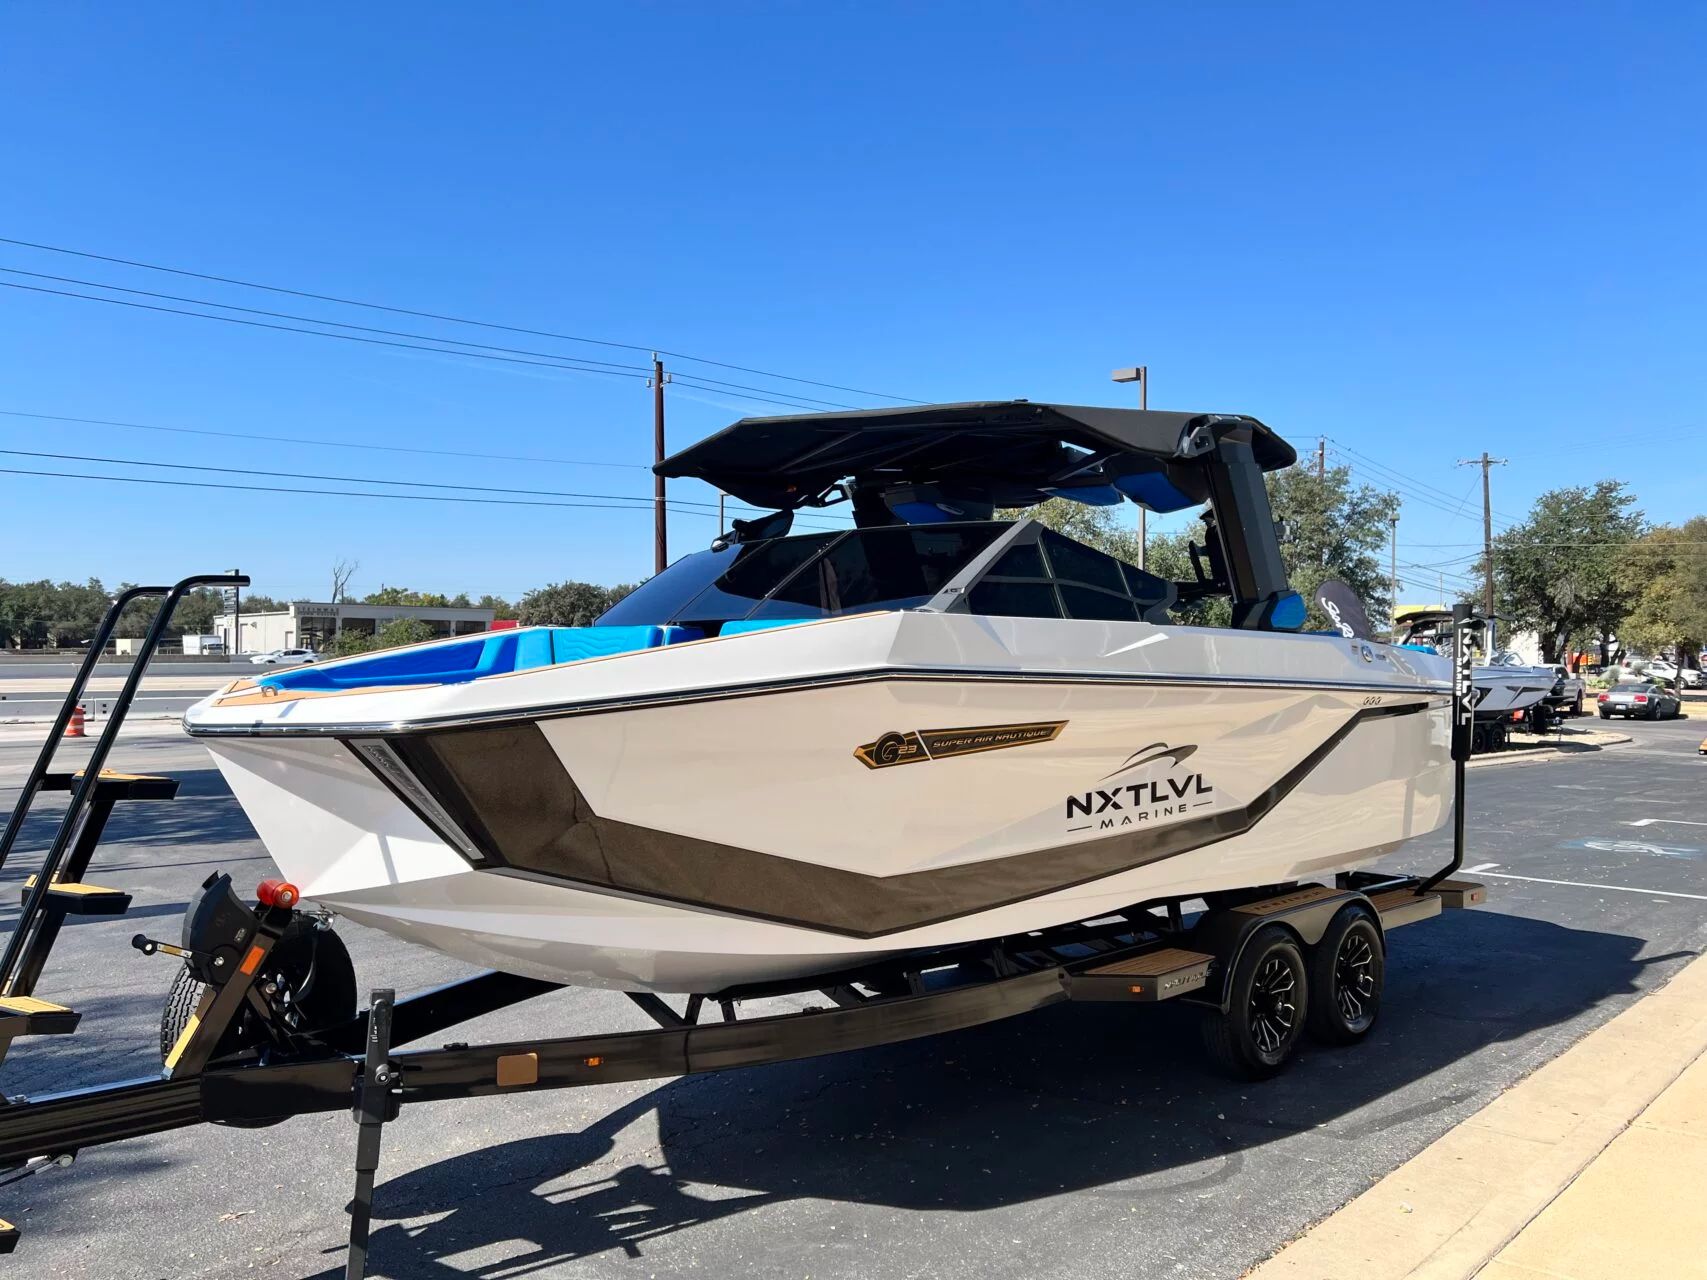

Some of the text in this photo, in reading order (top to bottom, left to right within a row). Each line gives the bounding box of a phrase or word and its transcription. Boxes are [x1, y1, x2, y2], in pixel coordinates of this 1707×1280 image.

[1461, 628, 1473, 725] NXTLVL
[932, 730, 1047, 748] SUPER AIR NAUTIQUE
[1067, 773, 1213, 819] NXTLVL
[1100, 803, 1187, 829] MARINE
